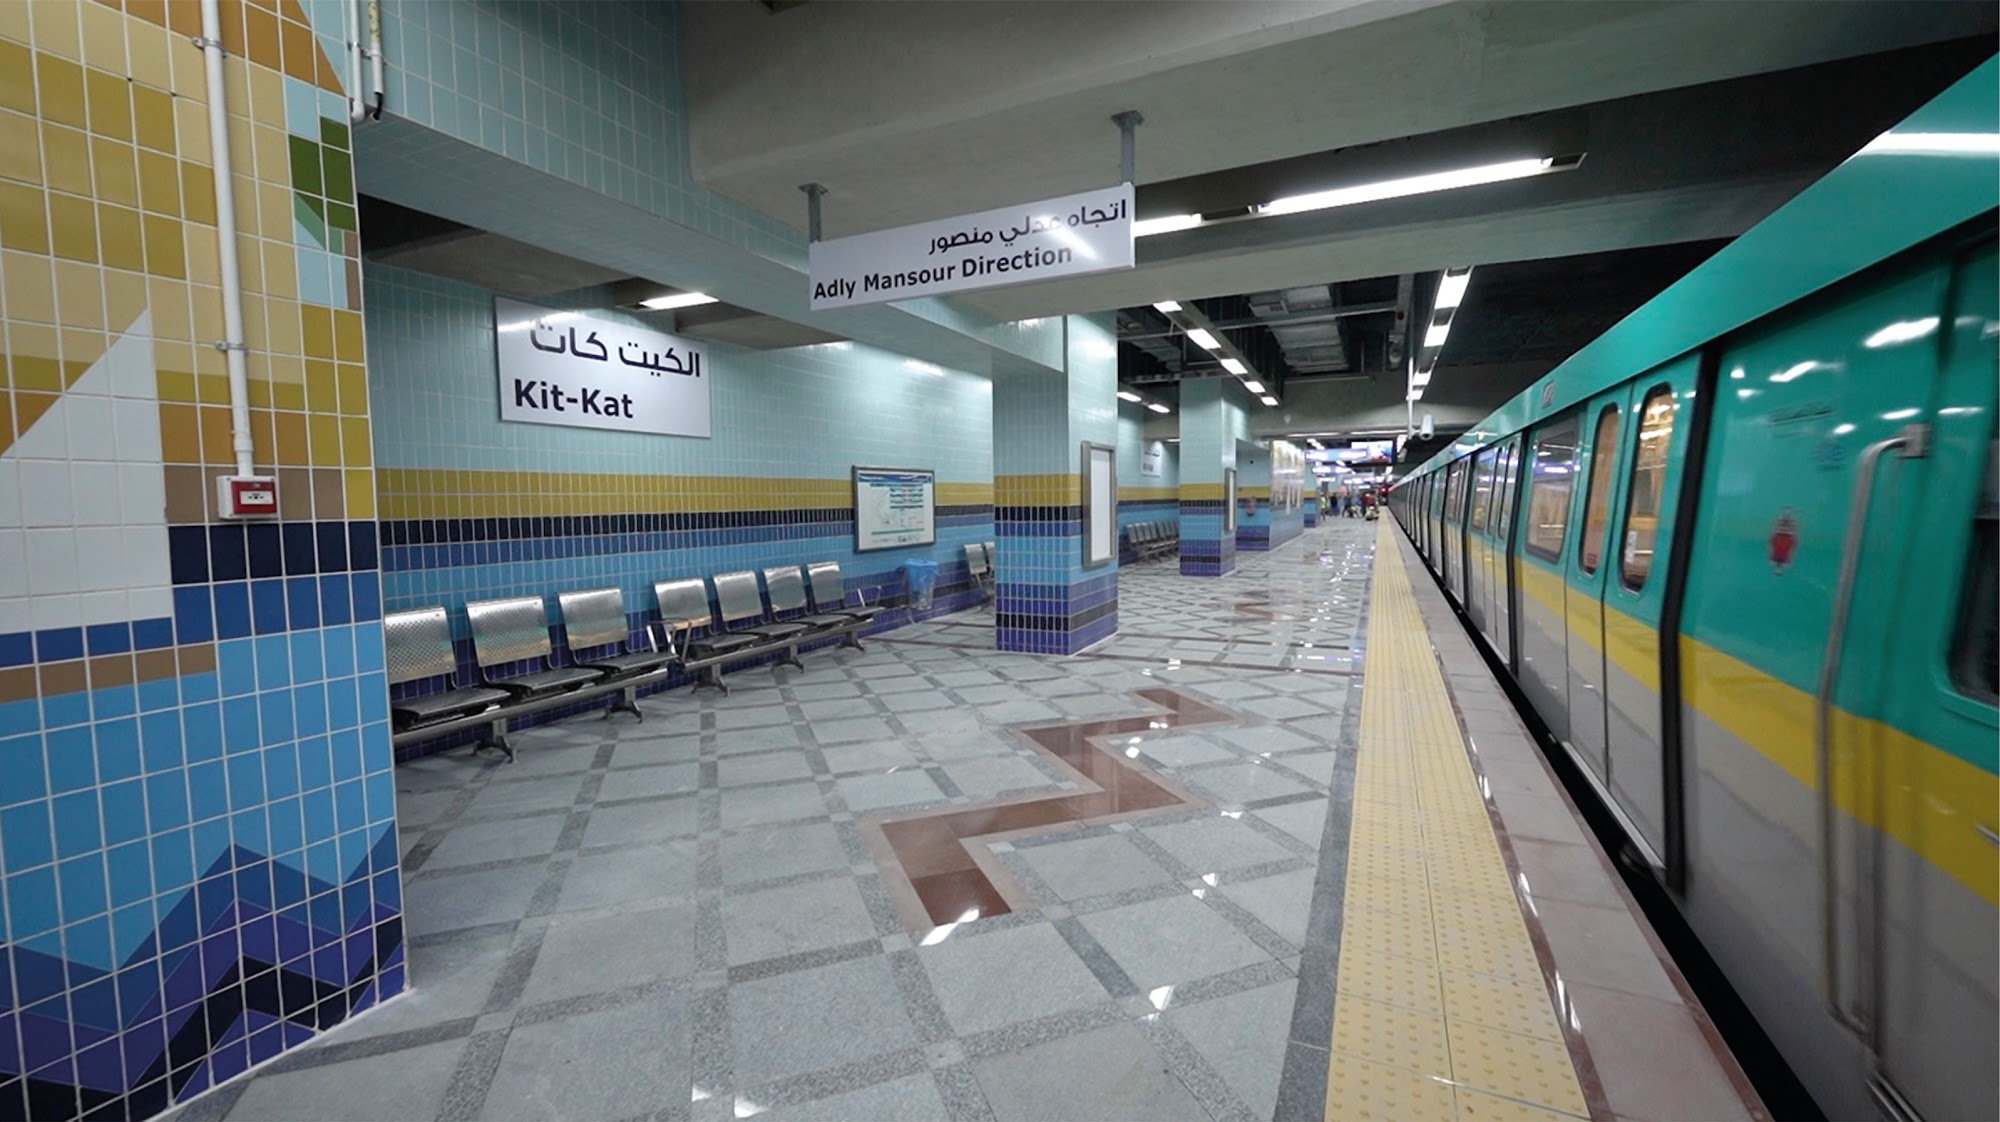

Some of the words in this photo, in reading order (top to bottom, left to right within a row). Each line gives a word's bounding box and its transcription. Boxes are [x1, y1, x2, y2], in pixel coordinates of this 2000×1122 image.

[999, 215, 1061, 247] عدلي
[1067, 199, 1126, 228] اتجاه
[929, 226, 993, 255] منصور
[813, 278, 856, 299] Adly
[864, 263, 956, 292] Mansour
[962, 247, 1072, 278] Direction
[529, 321, 608, 361] كات
[618, 341, 700, 378] الكيت
[514, 378, 633, 419] Kit-Kat
